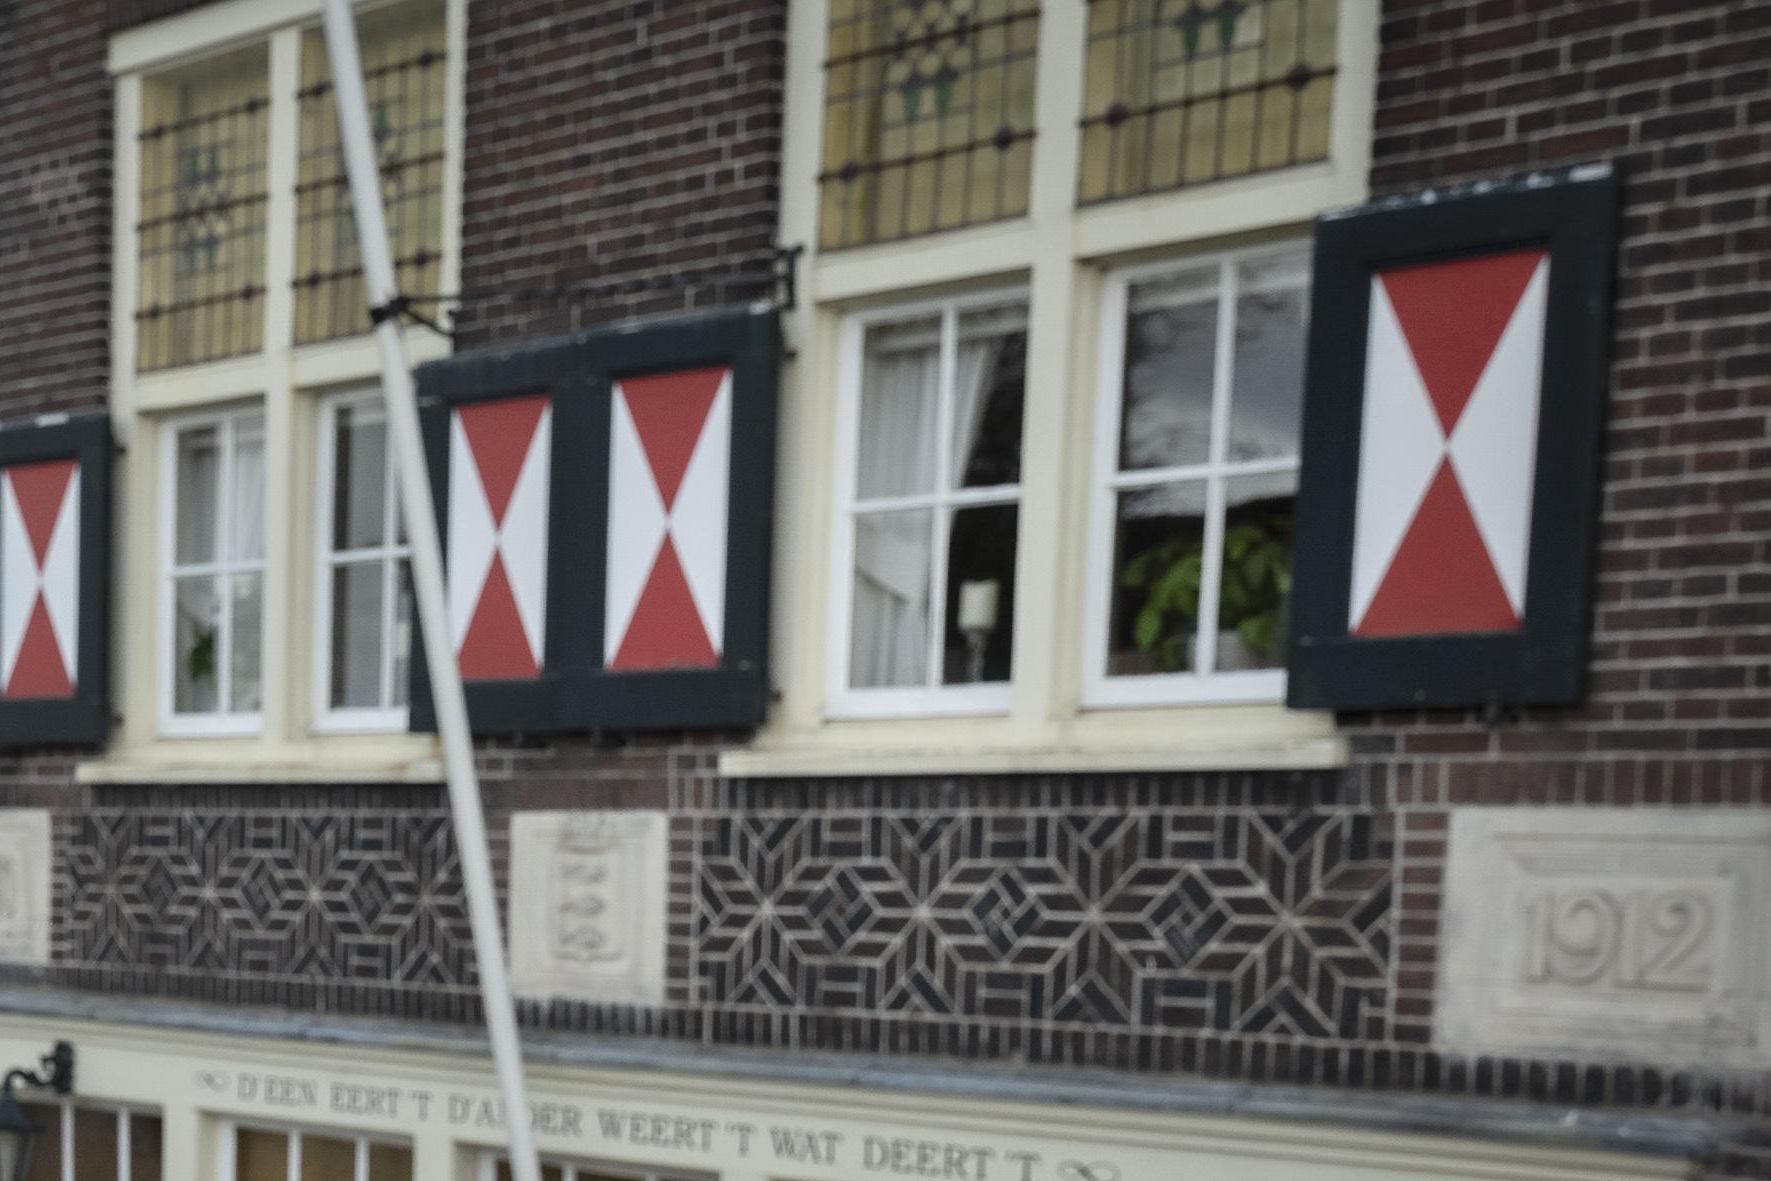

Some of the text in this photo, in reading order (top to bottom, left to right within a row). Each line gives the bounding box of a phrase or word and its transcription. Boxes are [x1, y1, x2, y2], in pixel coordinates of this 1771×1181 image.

[1522, 887, 1715, 993] 1912
[330, 1083, 404, 1118] EERT
[597, 1108, 717, 1152] WEERT
[770, 1126, 844, 1165] WAT
